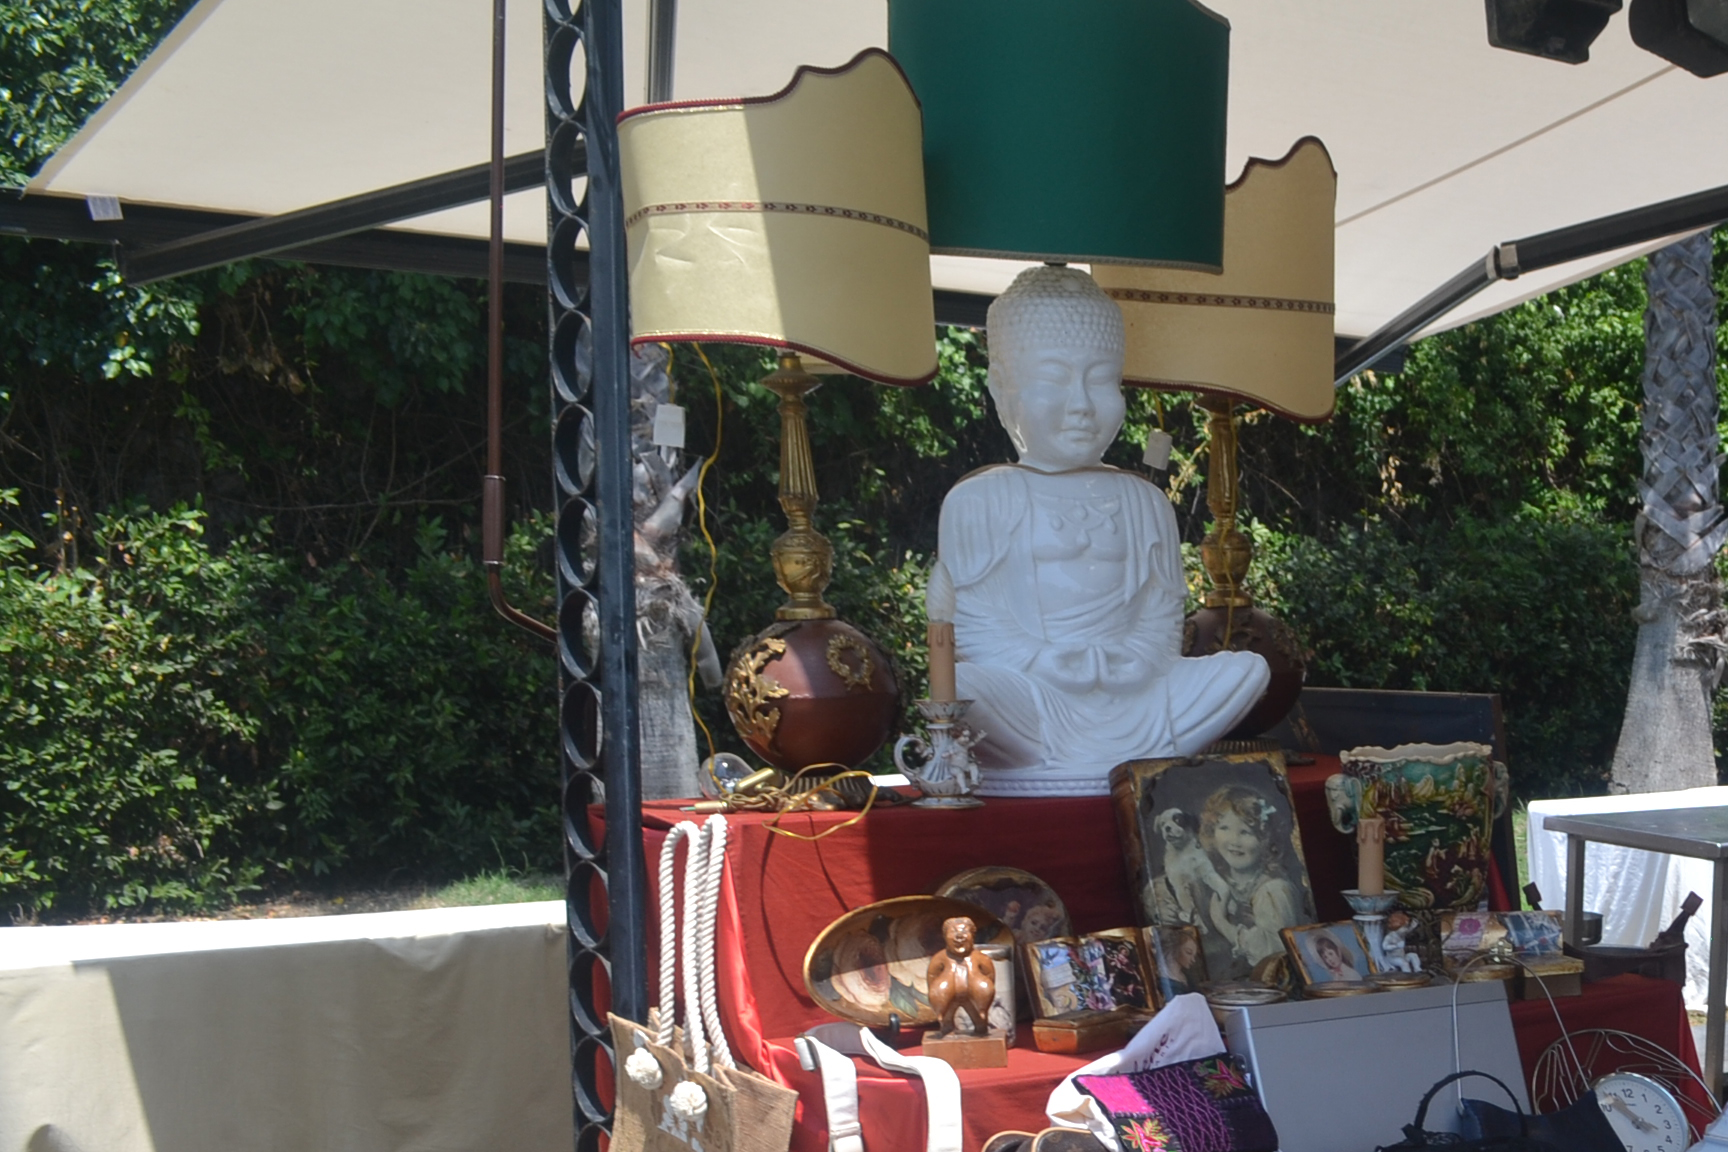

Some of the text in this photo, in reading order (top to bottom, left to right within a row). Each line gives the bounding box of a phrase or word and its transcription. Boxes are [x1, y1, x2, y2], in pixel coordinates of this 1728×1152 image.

[1621, 1088, 1634, 1099] 12
[1641, 1093, 1648, 1103] 1
[1654, 1104, 1663, 1115] 2
[1663, 1119, 1672, 1130] 3
[1665, 1135, 1673, 1144] 4
